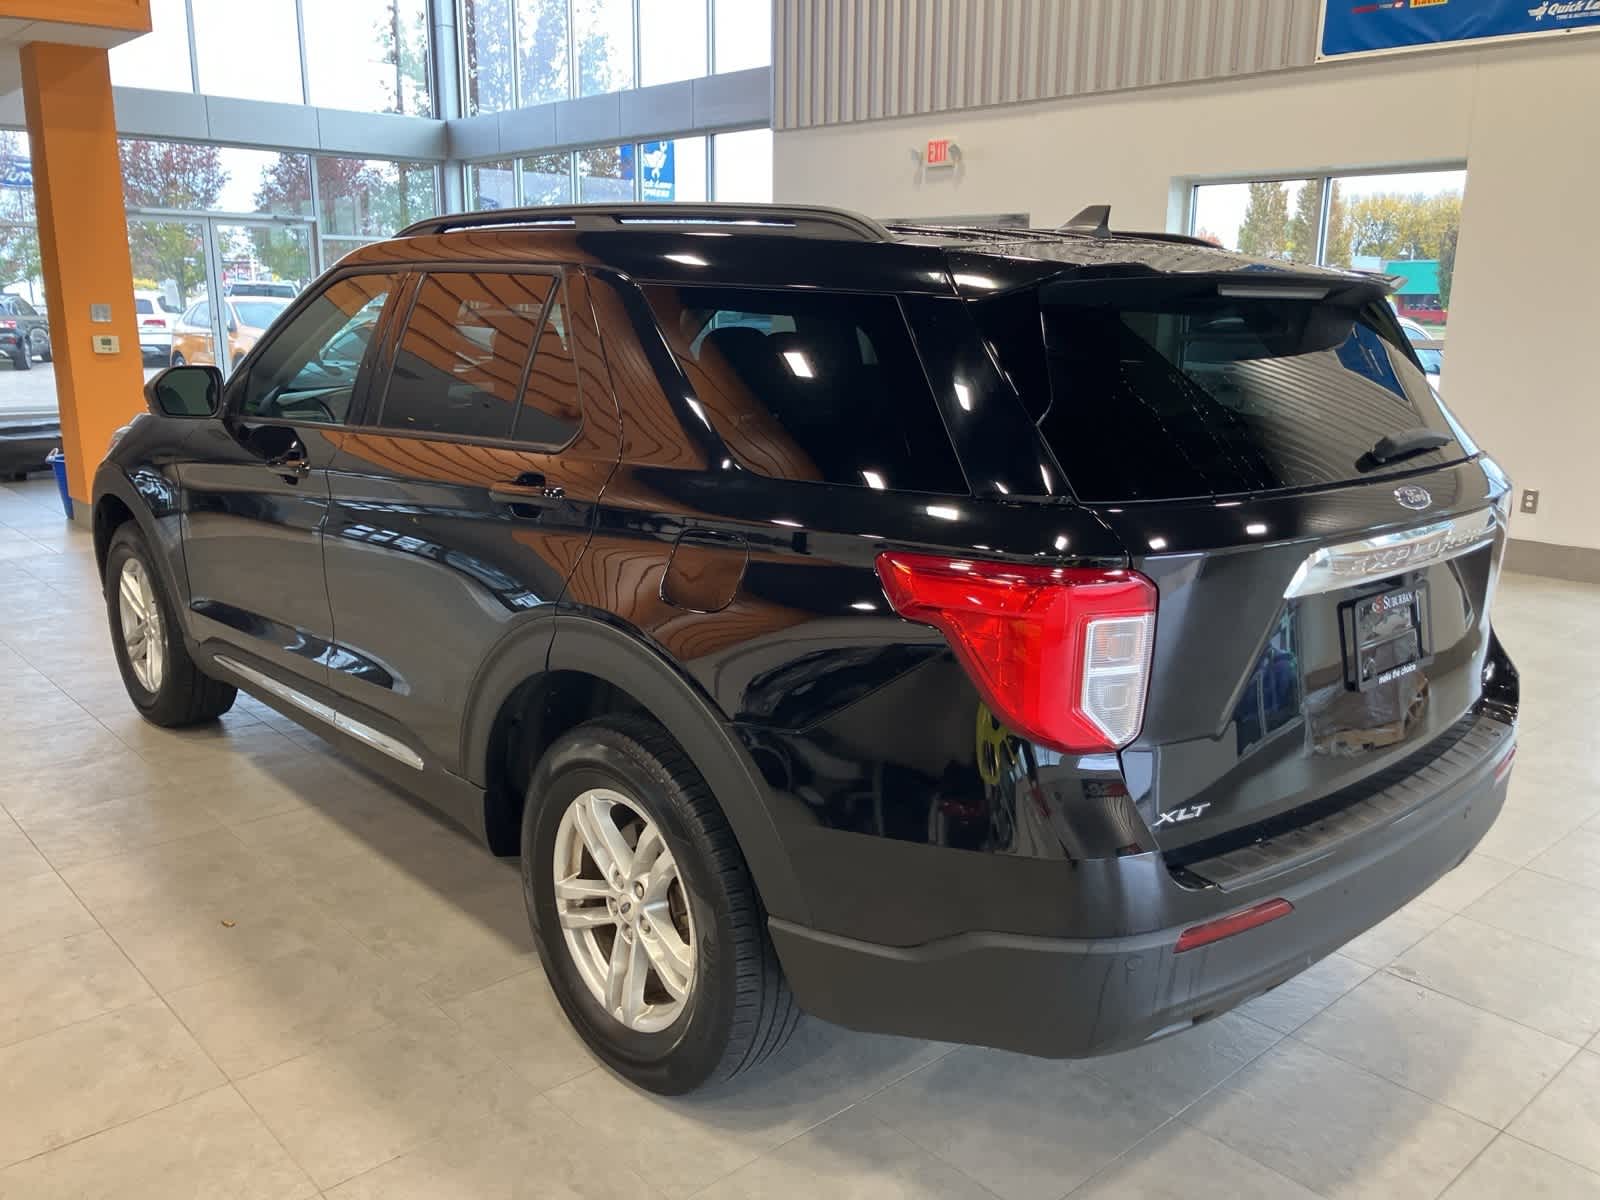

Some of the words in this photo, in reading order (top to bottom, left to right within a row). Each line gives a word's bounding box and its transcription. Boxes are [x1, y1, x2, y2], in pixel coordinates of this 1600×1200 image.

[1547, 1, 1585, 16] Quick
[927, 140, 950, 163] EXIT
[1152, 802, 1211, 826] XLT
